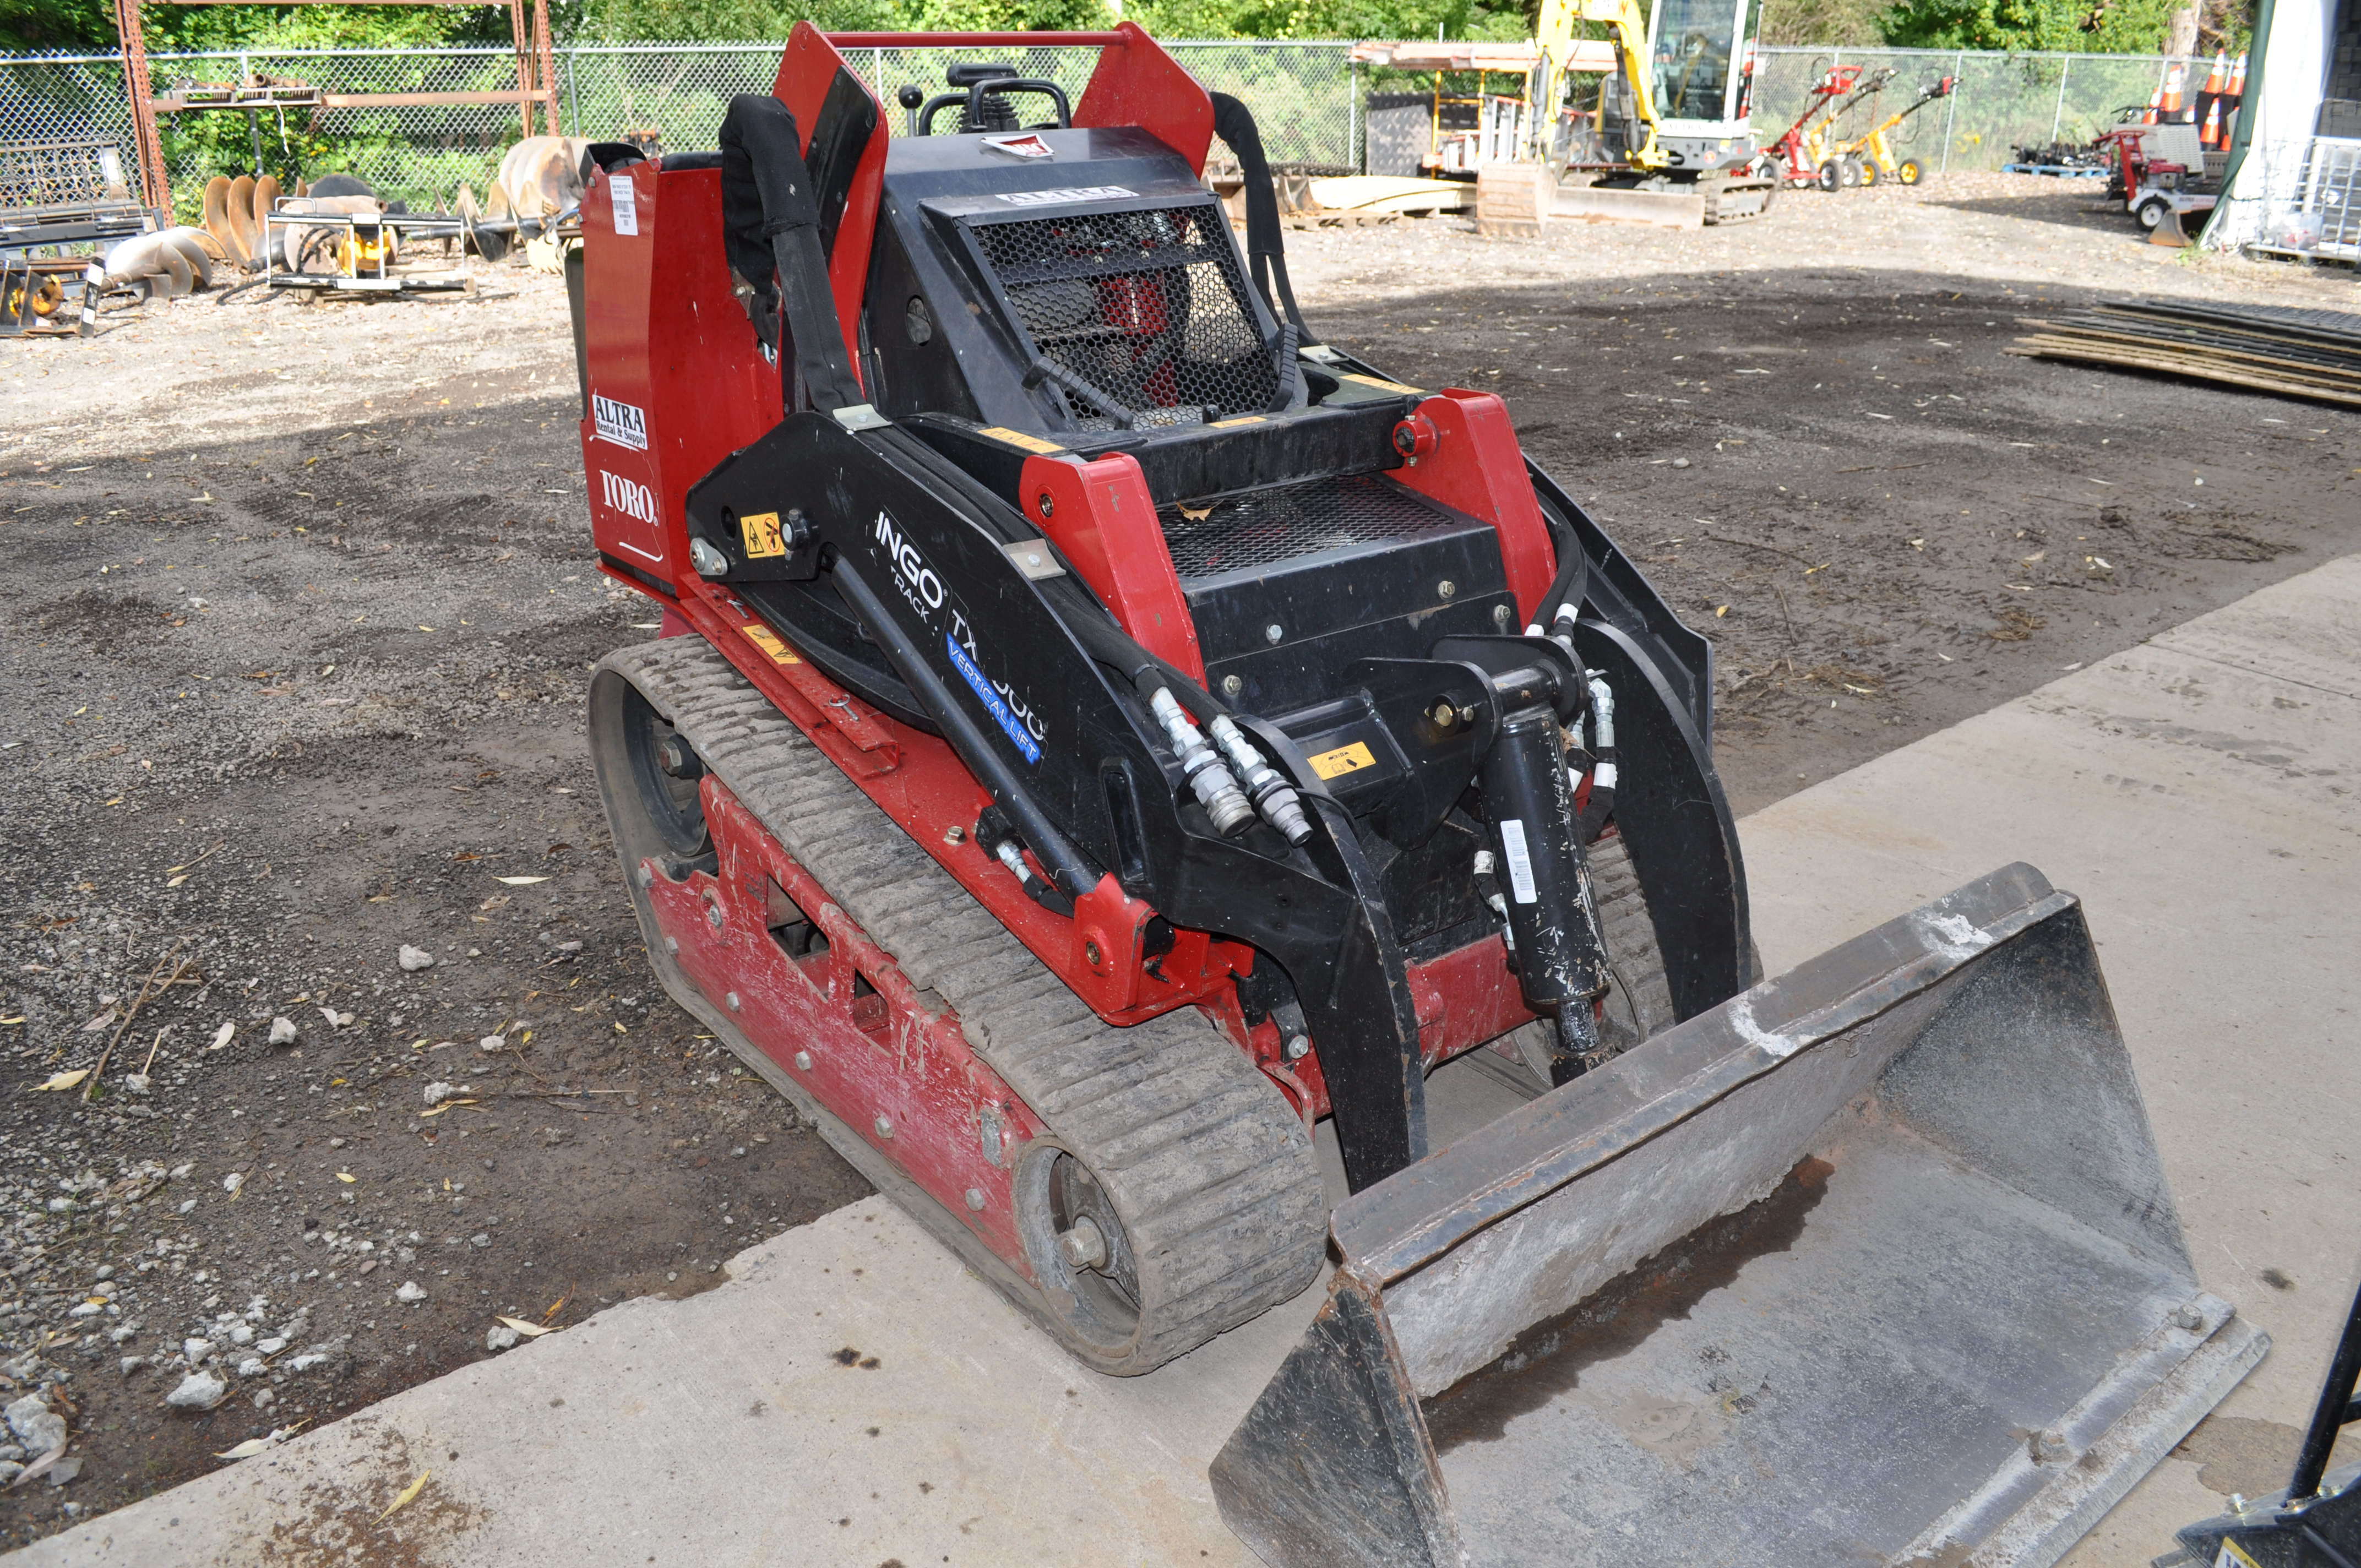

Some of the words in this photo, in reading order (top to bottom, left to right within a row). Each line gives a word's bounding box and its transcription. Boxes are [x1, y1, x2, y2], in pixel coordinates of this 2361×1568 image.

[596, 397, 644, 433] ALTRA
[596, 420, 616, 435] Rental
[617, 427, 622, 437] &
[624, 429, 645, 448] Supply
[600, 469, 654, 524] TORO
[949, 641, 1007, 725] VERTICAL
[1010, 721, 1037, 757] LIFT
